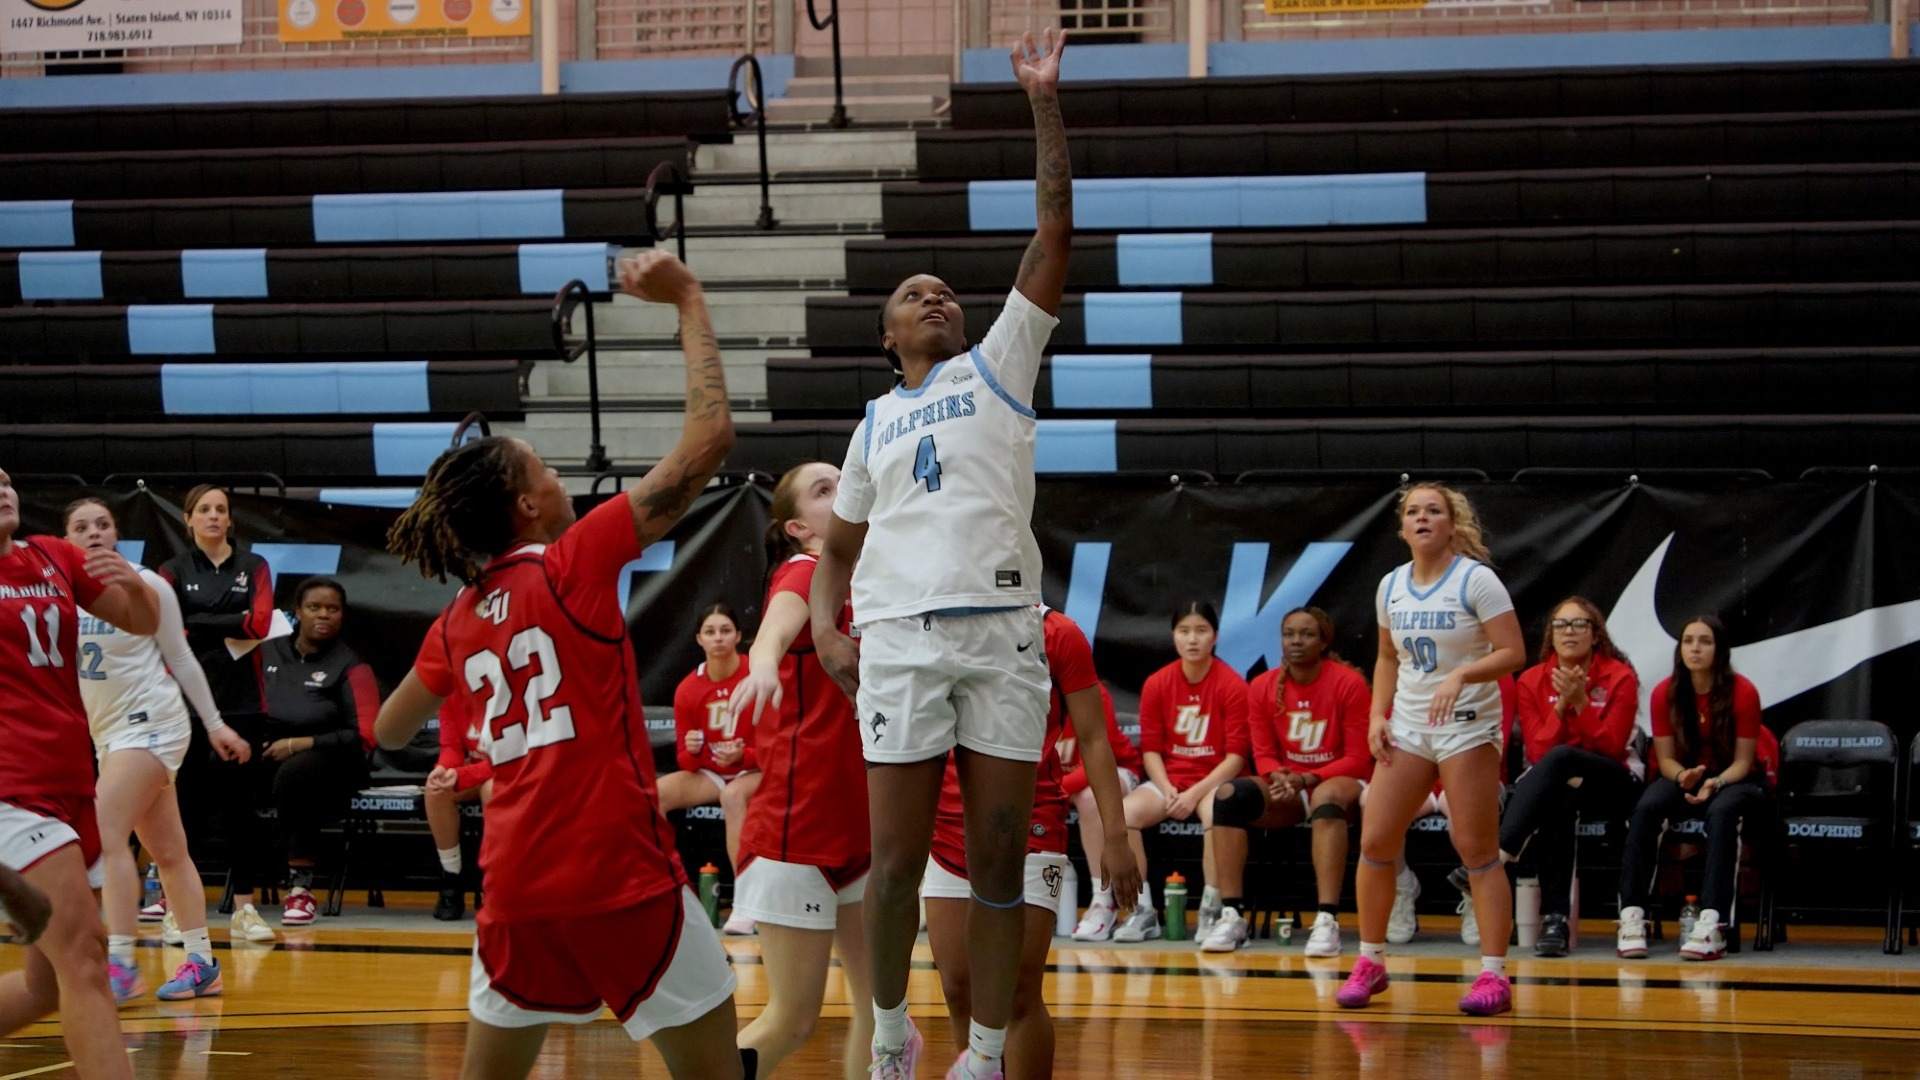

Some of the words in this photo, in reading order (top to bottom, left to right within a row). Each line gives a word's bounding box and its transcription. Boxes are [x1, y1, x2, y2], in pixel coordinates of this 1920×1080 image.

[11, 18, 33, 29] 1447
[37, 15, 84, 28] Richmond
[86, 15, 105, 25] Ave.
[116, 13, 147, 24] Staten
[150, 11, 182, 23] Island,
[185, 11, 198, 21] NY
[202, 10, 232, 21] 10314
[87, 29, 152, 42] 718.983.6912
[913, 434, 942, 493] 4
[79, 615, 116, 635] HINS
[1391, 610, 1456, 630] DOLPHINS
[20, 603, 64, 667] 11
[1403, 636, 1437, 673] 10
[464, 626, 576, 766] 22
[1796, 737, 1839, 747] STATEN
[1841, 736, 1883, 747] ISLAND
[351, 798, 414, 811] DOLPHINS
[1788, 824, 1863, 837] DOLPHINS
